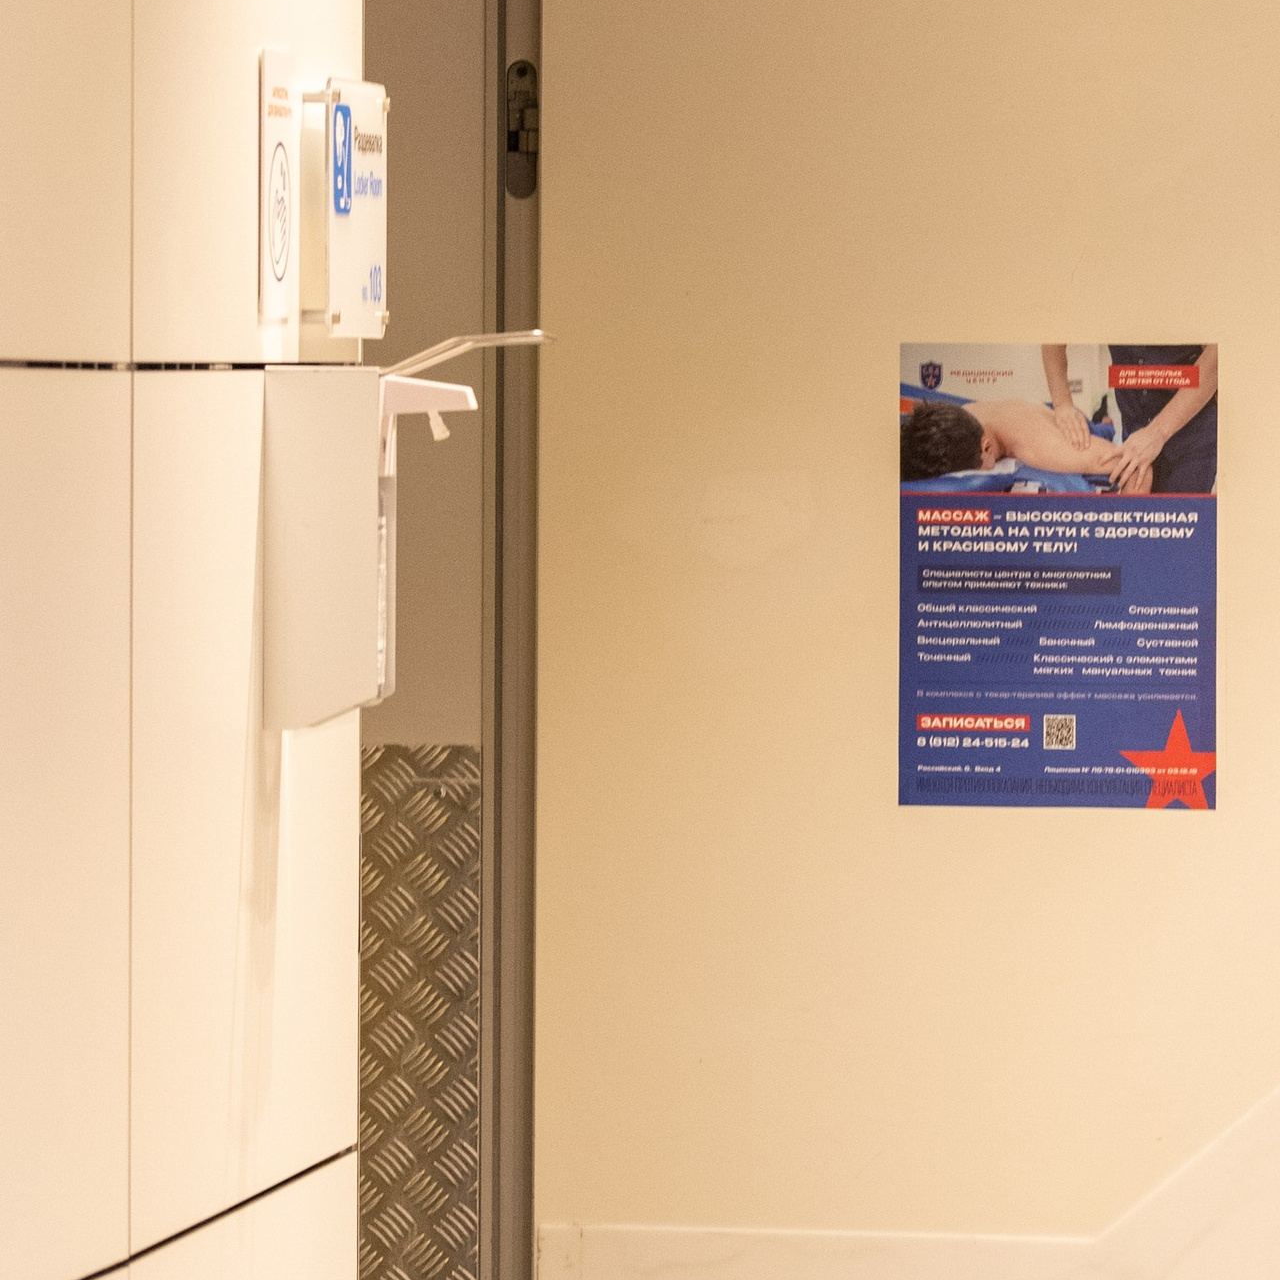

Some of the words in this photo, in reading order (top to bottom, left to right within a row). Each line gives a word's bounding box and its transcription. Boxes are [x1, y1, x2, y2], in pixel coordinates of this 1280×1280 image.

[369, 266, 383, 303] 103
[918, 509, 990, 522] МАССАЖ
[1005, 510, 1199, 523] ВЫСОКОЭФФЕКТИВНАЯ
[918, 525, 1004, 538] МЕТОДИКА
[1007, 525, 1030, 538] НА
[1034, 526, 1077, 539] ПУТИ
[1080, 526, 1090, 538] К
[1094, 527, 1195, 539] ЗДОРОВОМУ
[918, 540, 929, 552] И
[932, 541, 1029, 553] КРАСИВОМУ
[1032, 541, 1078, 554] ТЕЛУ!
[922, 568, 993, 579] Специалисты
[994, 571, 1031, 580] центра
[1041, 571, 1112, 580] многолетним
[922, 580, 963, 589] опытом
[964, 581, 1022, 591] применяют
[917, 602, 956, 614] Общий
[958, 604, 1038, 614] классический
[1128, 605, 1199, 616] Спортивный
[917, 618, 1023, 630] Антицеллюлитный
[1093, 620, 1199, 632] Лимфодренажный
[916, 635, 1001, 646] Висцеральный
[1039, 636, 1096, 647] Баночный
[1136, 637, 1199, 649] Суставной
[917, 651, 972, 662] Точечный
[1033, 653, 1114, 664] Классический
[1125, 655, 1198, 665] элементами
[1033, 666, 1074, 675] мягких
[1081, 667, 1153, 677] мануальных
[1158, 668, 1197, 676] техник
[920, 716, 1026, 729] ЗАПИСАТЬСЯ
